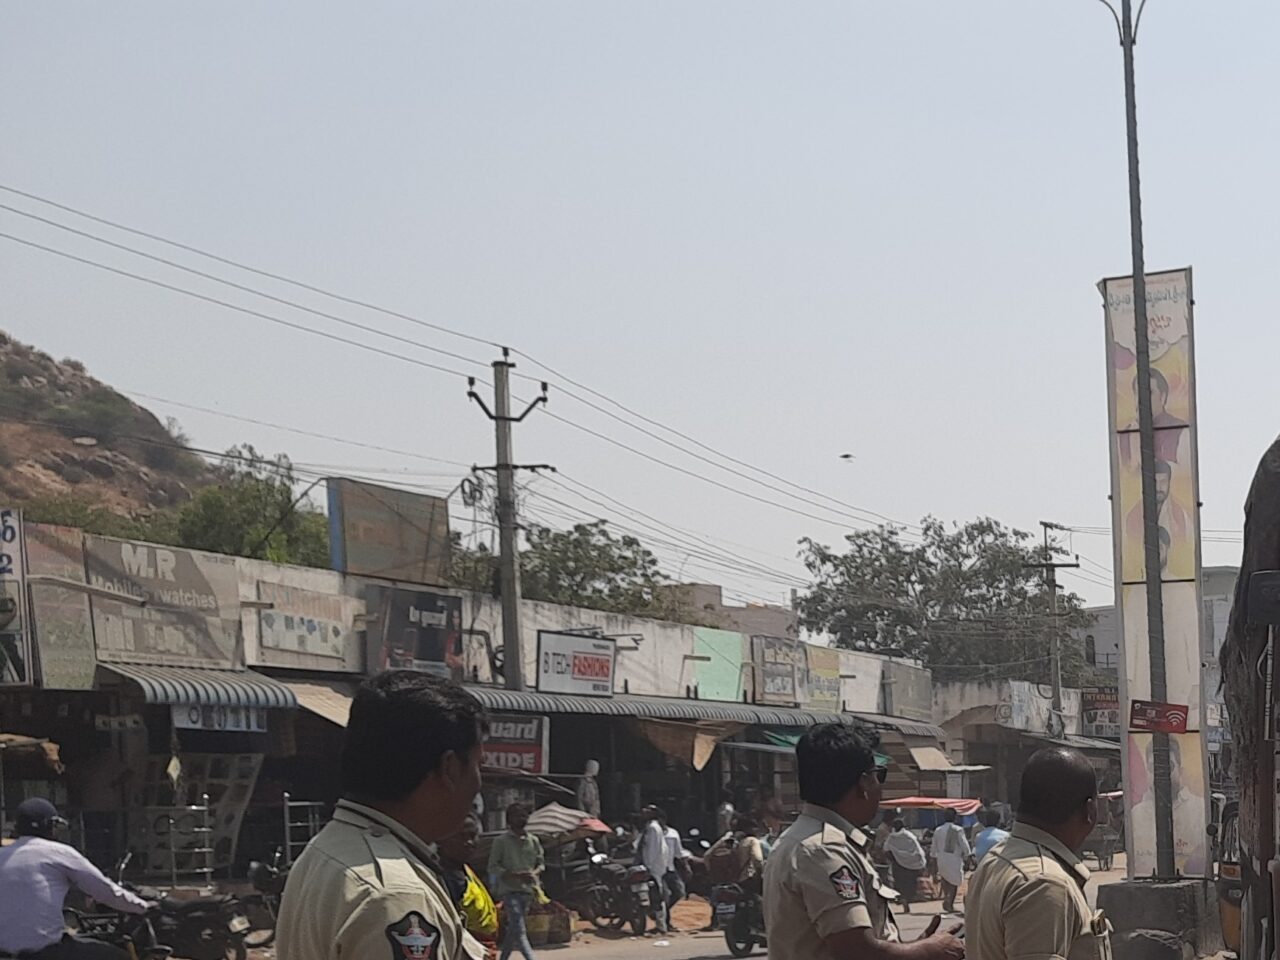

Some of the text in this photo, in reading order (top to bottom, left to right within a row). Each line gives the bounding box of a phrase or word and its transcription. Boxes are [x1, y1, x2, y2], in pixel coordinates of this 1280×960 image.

[160, 588, 217, 608] watches
[489, 718, 539, 740] uard
[483, 751, 536, 769] XIDE
